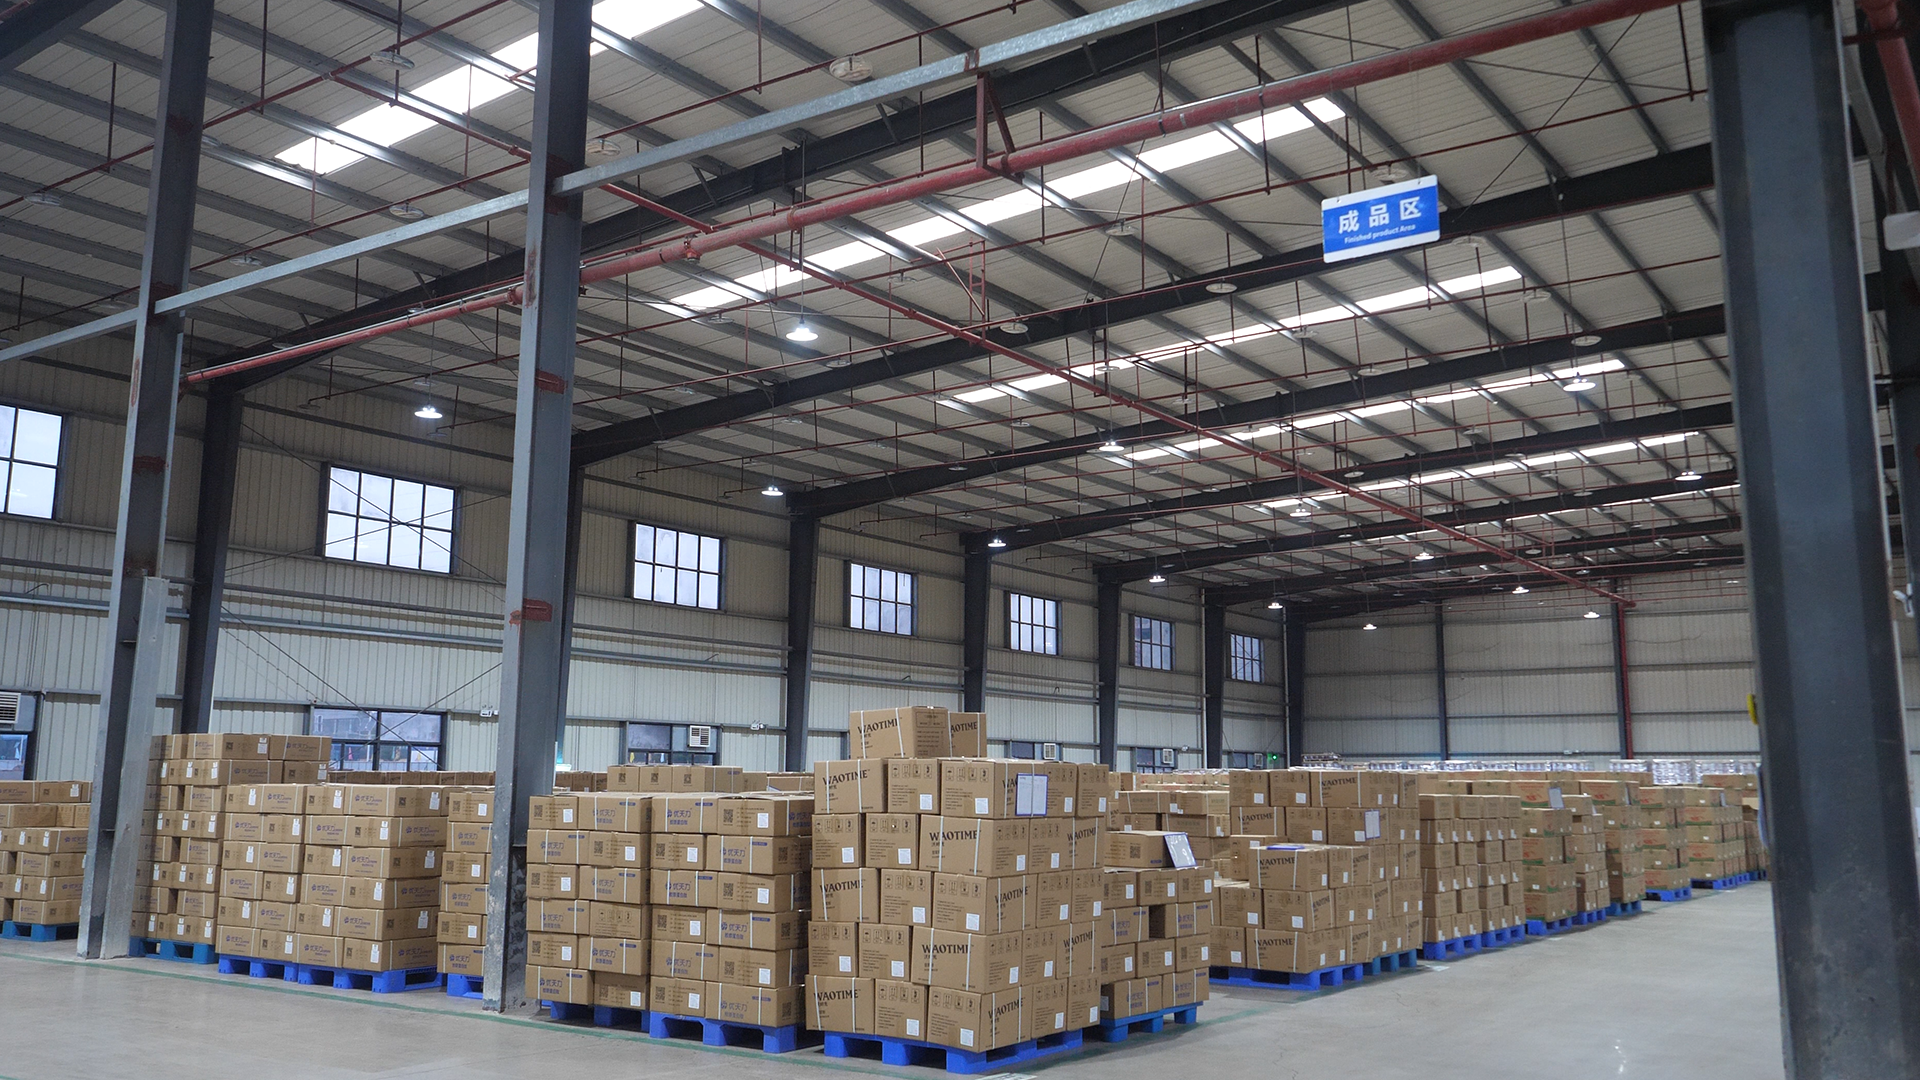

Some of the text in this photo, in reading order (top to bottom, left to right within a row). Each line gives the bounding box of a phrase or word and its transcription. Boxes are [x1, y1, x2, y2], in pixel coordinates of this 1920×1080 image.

[1339, 197, 1421, 234] 成品区
[1345, 223, 1416, 243] Finished product Area
[950, 721, 978, 733] AOTIME
[929, 830, 978, 842] WAOTIME
